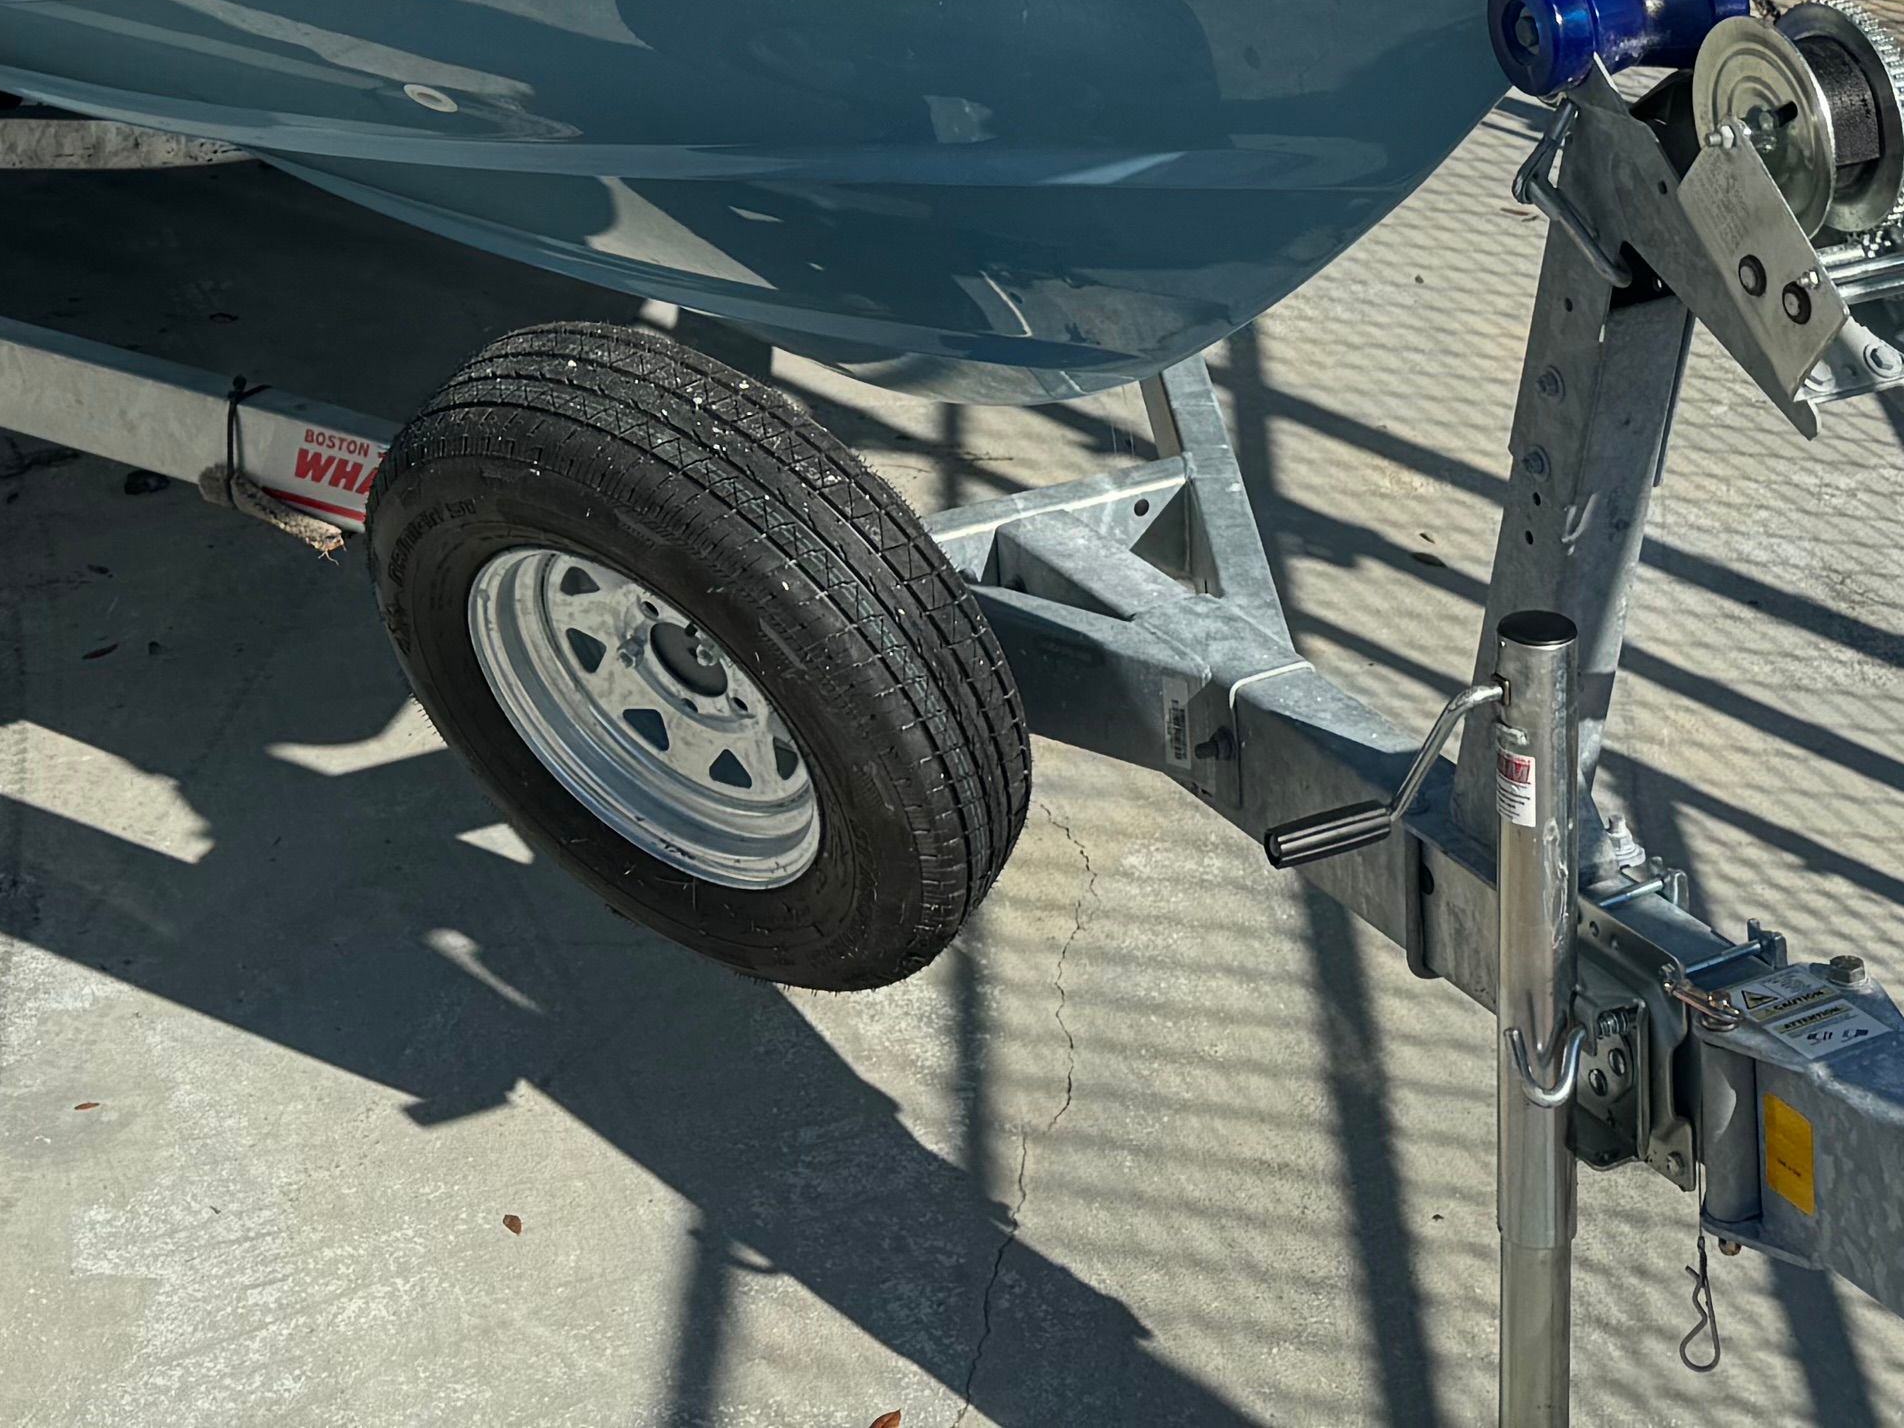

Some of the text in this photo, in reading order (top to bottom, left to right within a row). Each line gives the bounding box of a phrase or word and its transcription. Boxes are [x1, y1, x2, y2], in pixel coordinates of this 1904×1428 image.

[304, 428, 370, 458] BOSTON
[295, 447, 379, 495] WHA
[1774, 988, 1825, 1011] CAUTION
[1784, 1006, 1841, 1029] ATTENTION
